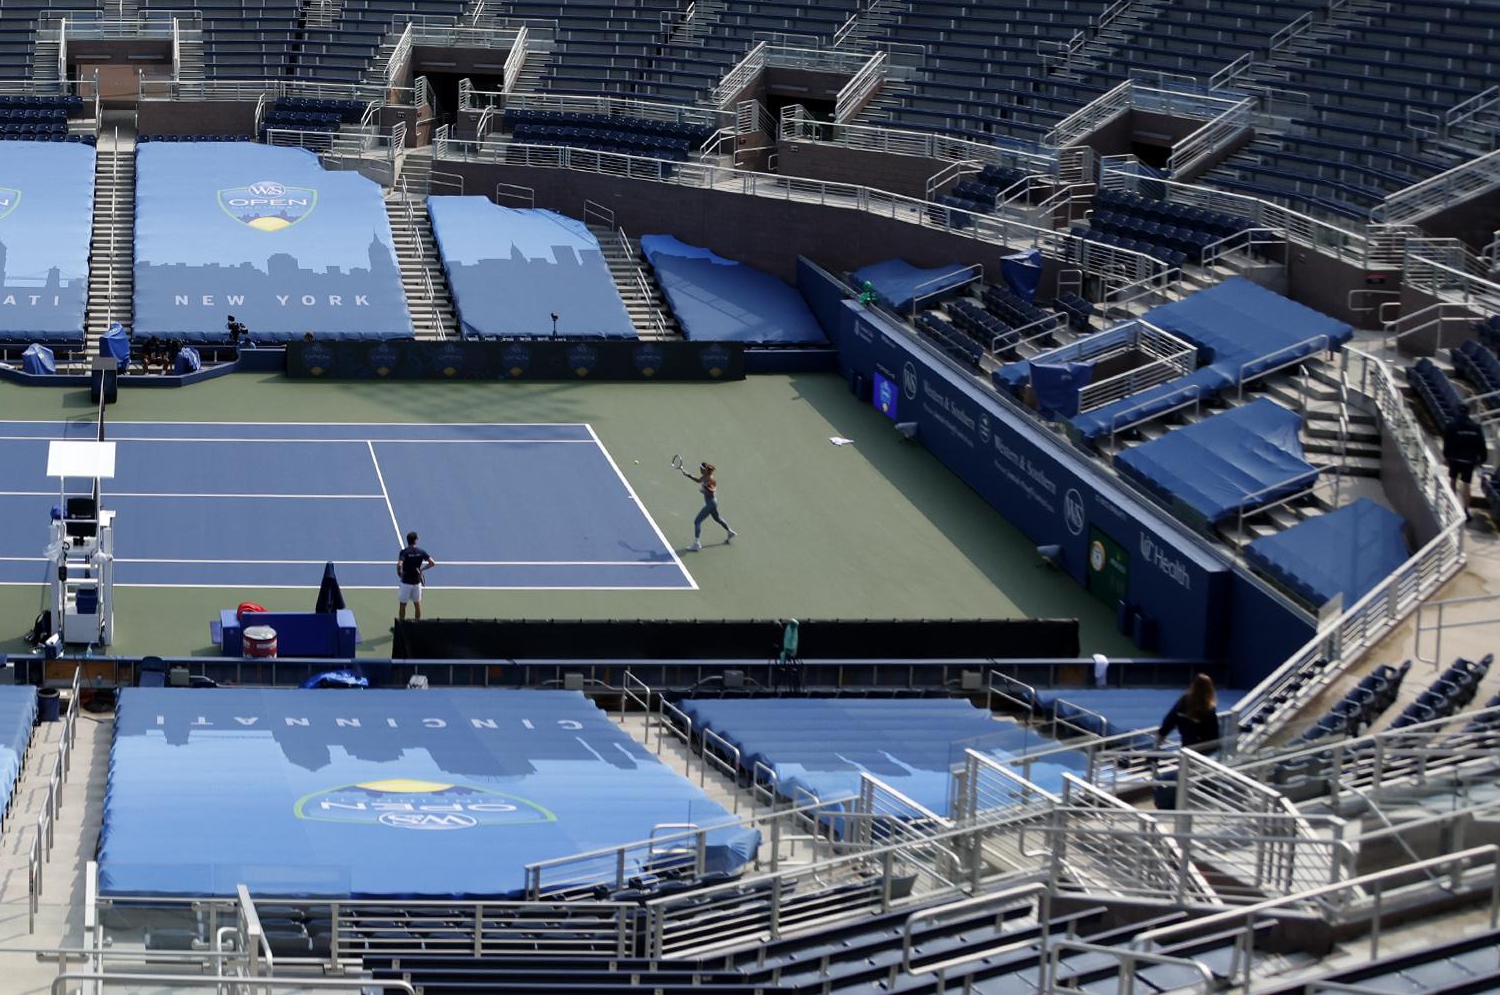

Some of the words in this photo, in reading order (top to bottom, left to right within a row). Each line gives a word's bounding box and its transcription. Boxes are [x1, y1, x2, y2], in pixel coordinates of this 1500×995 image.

[228, 198, 308, 206] OPEN
[175, 294, 245, 306] NEW
[276, 294, 370, 306] YORK
[1154, 545, 1191, 590] Health
[156, 714, 584, 730] CINCINNATI
[320, 801, 517, 812] OPEN
